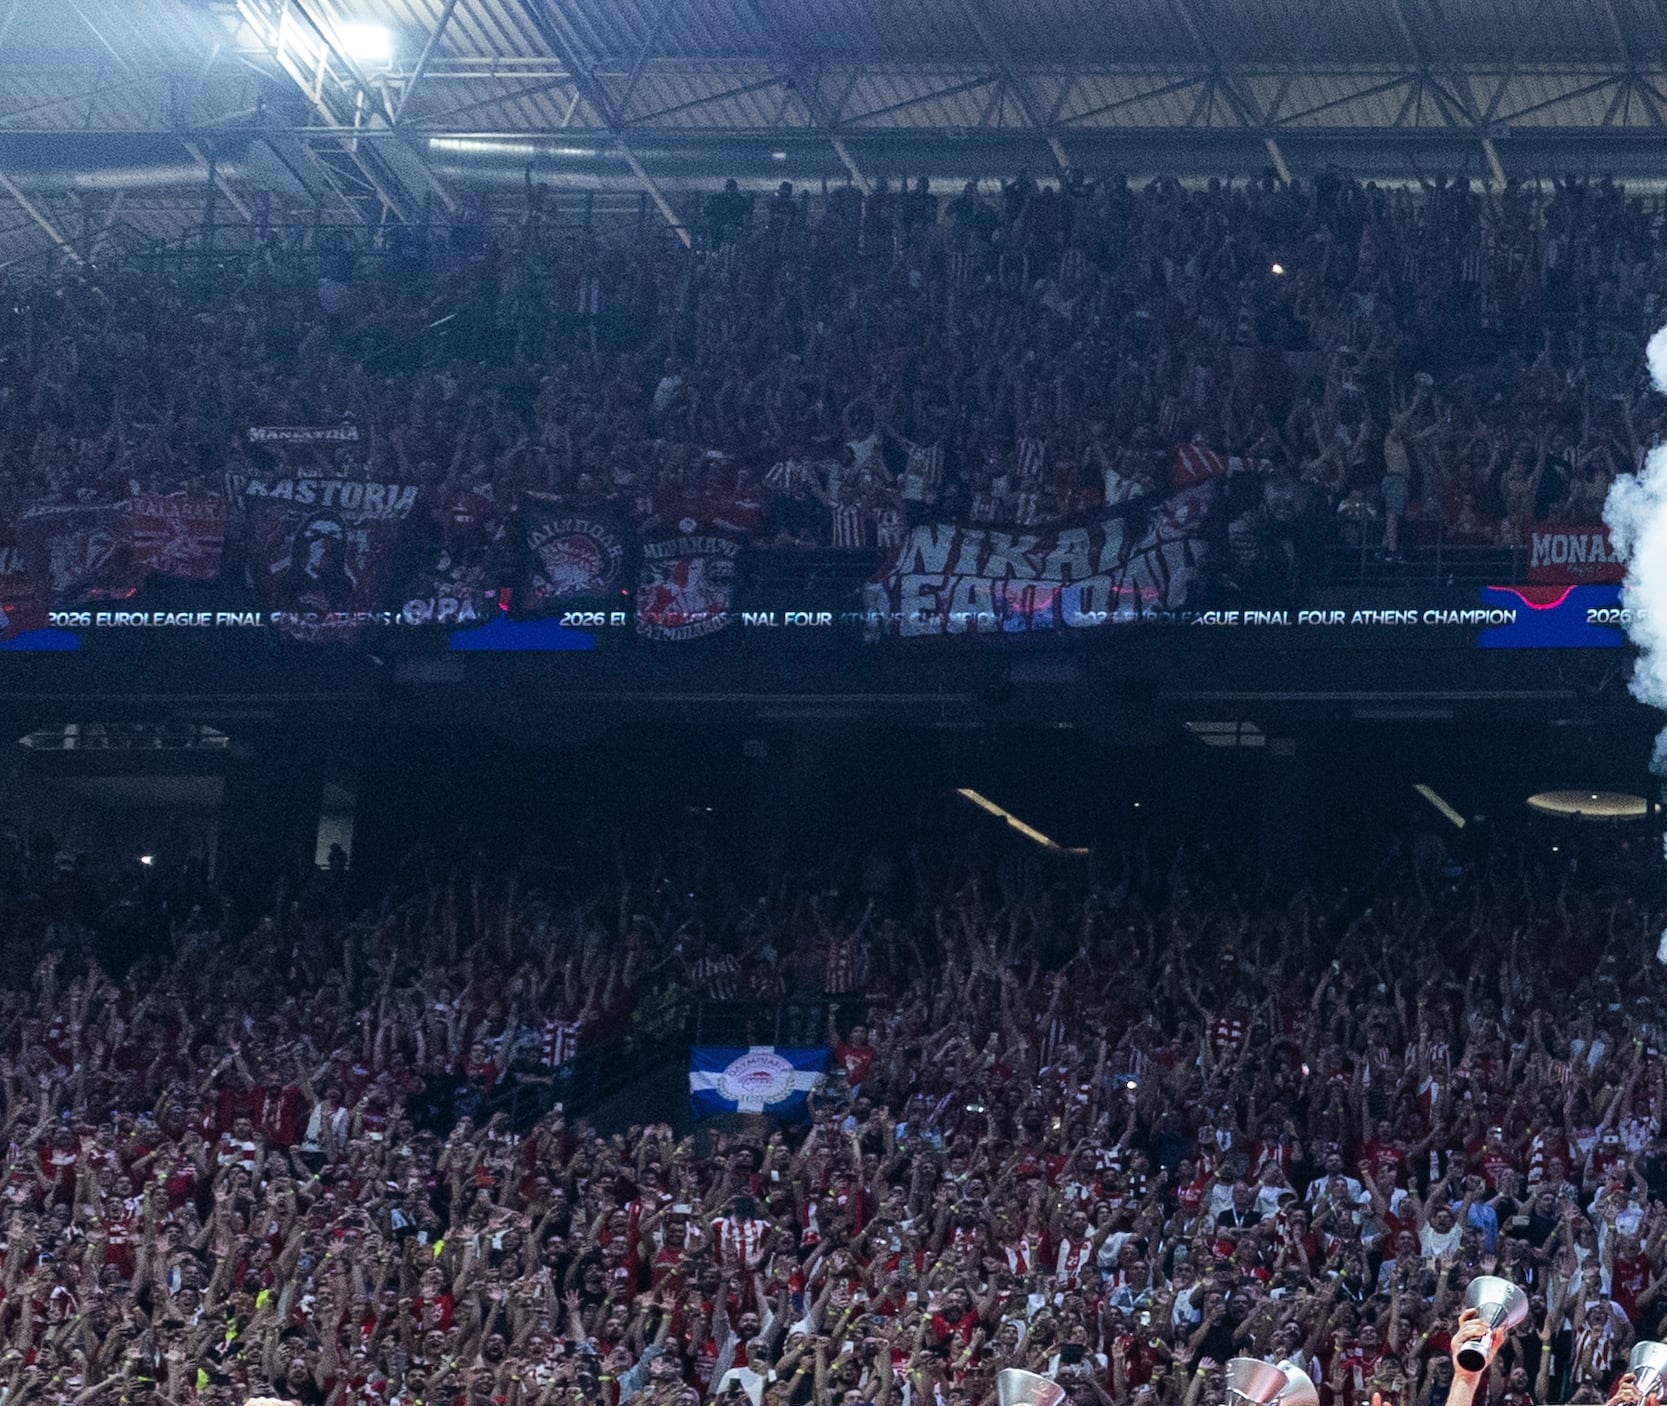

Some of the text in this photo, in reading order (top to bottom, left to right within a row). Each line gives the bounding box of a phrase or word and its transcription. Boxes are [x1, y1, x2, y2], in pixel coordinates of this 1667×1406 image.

[245, 478, 418, 520] KASTORIA
[48, 612, 91, 627] 2026
[96, 612, 213, 627] EUROLEAGUE
[216, 612, 264, 627] FINAL
[559, 611, 606, 627] 2026
[739, 611, 779, 627] NAL
[784, 611, 832, 627] FOUR
[1243, 611, 1293, 626] FINAL
[1297, 610, 1346, 626] FOUR
[1350, 610, 1418, 625] ATHENS
[1422, 609, 1517, 625] CHAMPION
[1586, 609, 1631, 624] 2026
